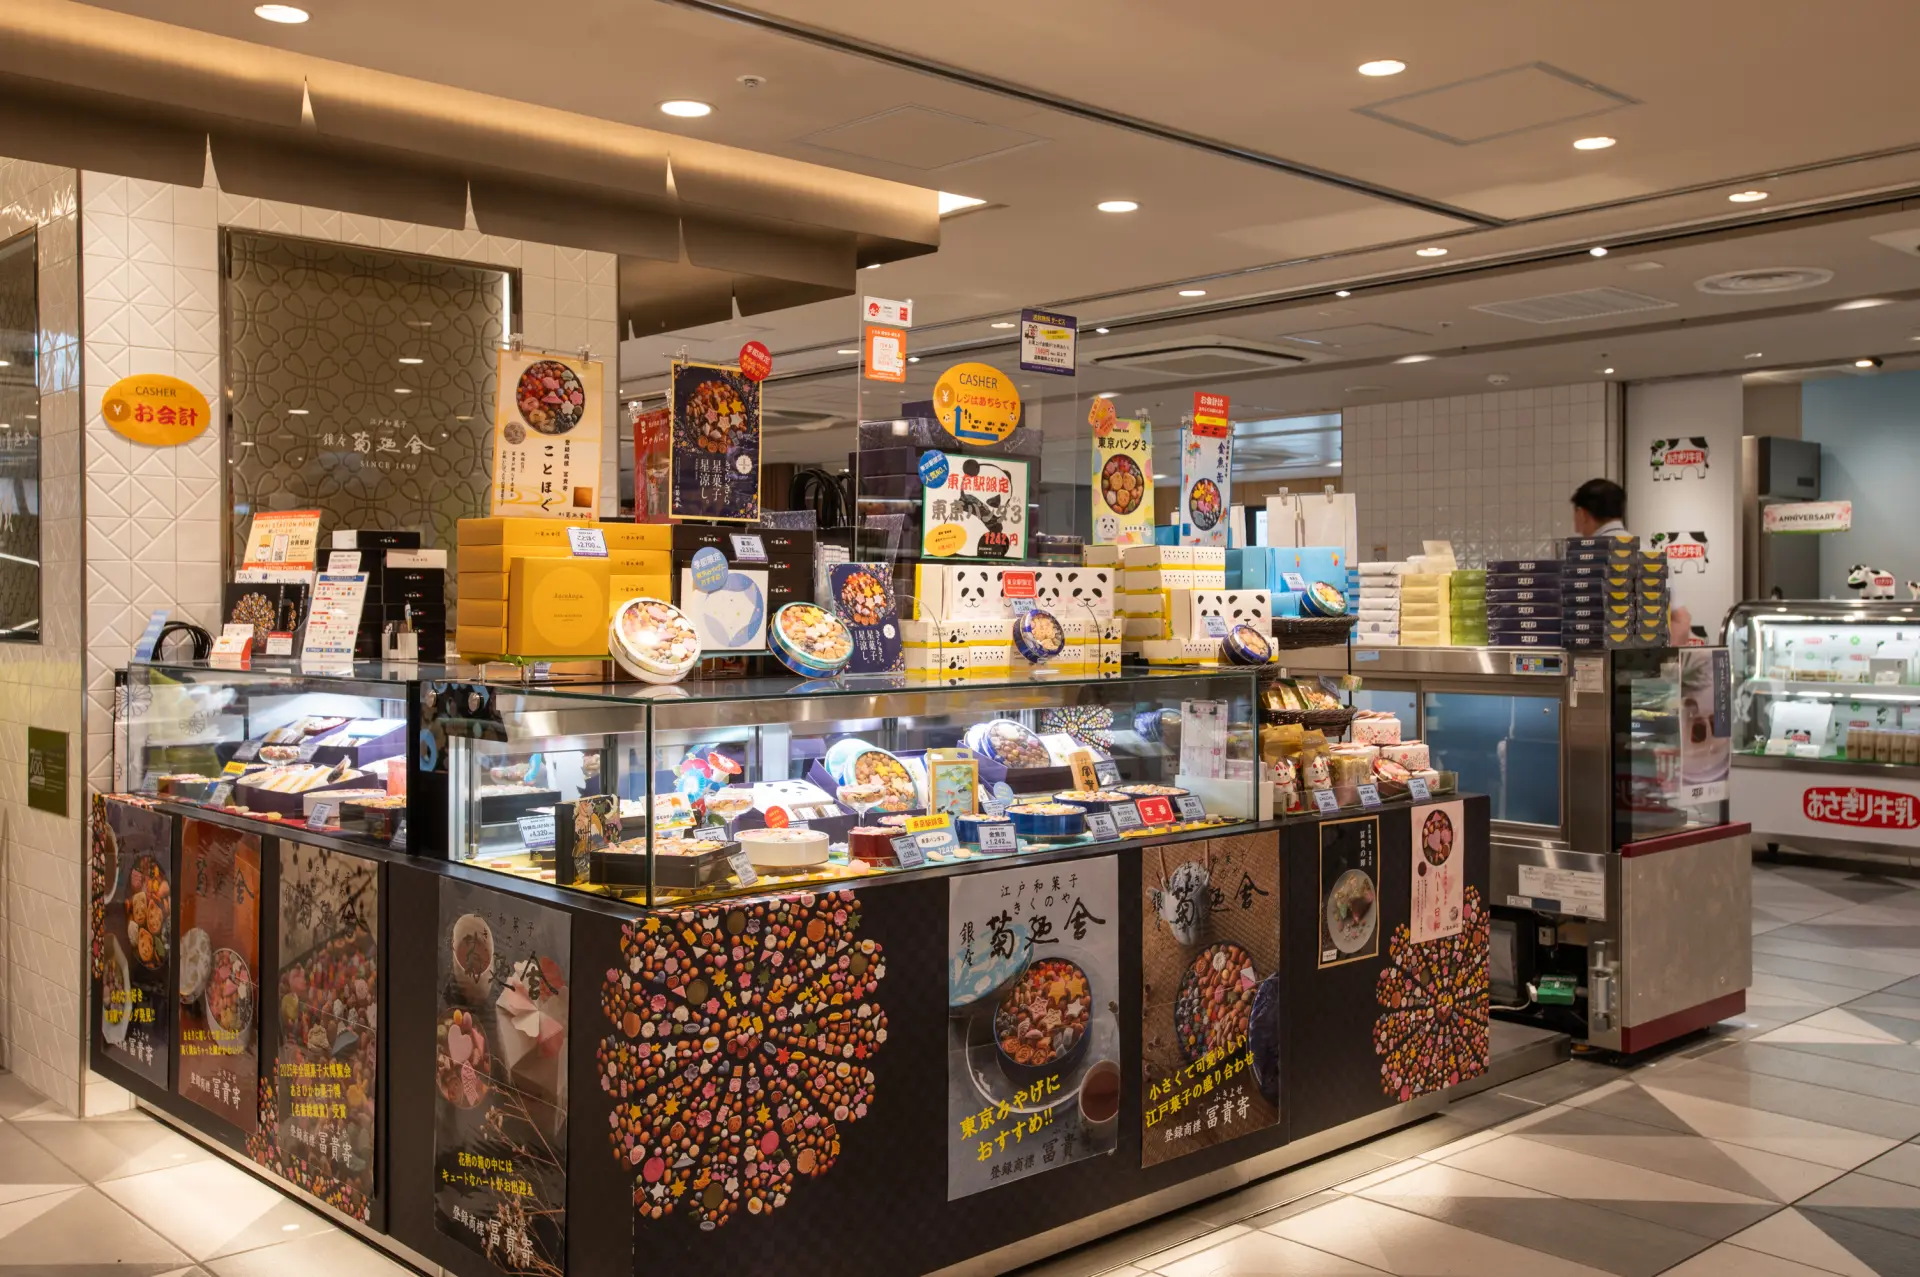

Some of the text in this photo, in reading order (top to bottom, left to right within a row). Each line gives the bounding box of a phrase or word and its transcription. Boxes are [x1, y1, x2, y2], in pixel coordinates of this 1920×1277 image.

[135, 386, 177, 398] CASHER
[959, 373, 998, 389] CASHER
[134, 403, 199, 427] お会計
[1097, 436, 1148, 451] 東京パンダ3
[359, 460, 390, 470] SINCE
[540, 445, 554, 512] ことほぐ
[712, 460, 723, 501] 星菓子
[947, 473, 1009, 493] 東京駅限定
[1778, 512, 1836, 522] ANNIVERSARY
[1806, 788, 1918, 827] あさぎり牛乳
[913, 818, 944, 828] 東京駅限定
[1001, 873, 1078, 898] 江戸和菓子
[1014, 893, 1071, 915] きくのや
[1149, 1034, 1247, 1101] 小さくて可愛らしい
[290, 1083, 341, 1099] あさひかわ菓子博
[1145, 1051, 1255, 1128] 江戸菓子の盛り合わせ
[960, 1074, 1061, 1141] 東京みやげに
[977, 1107, 1054, 1162] おすすめ!!
[453, 1205, 485, 1237] 登録商標
